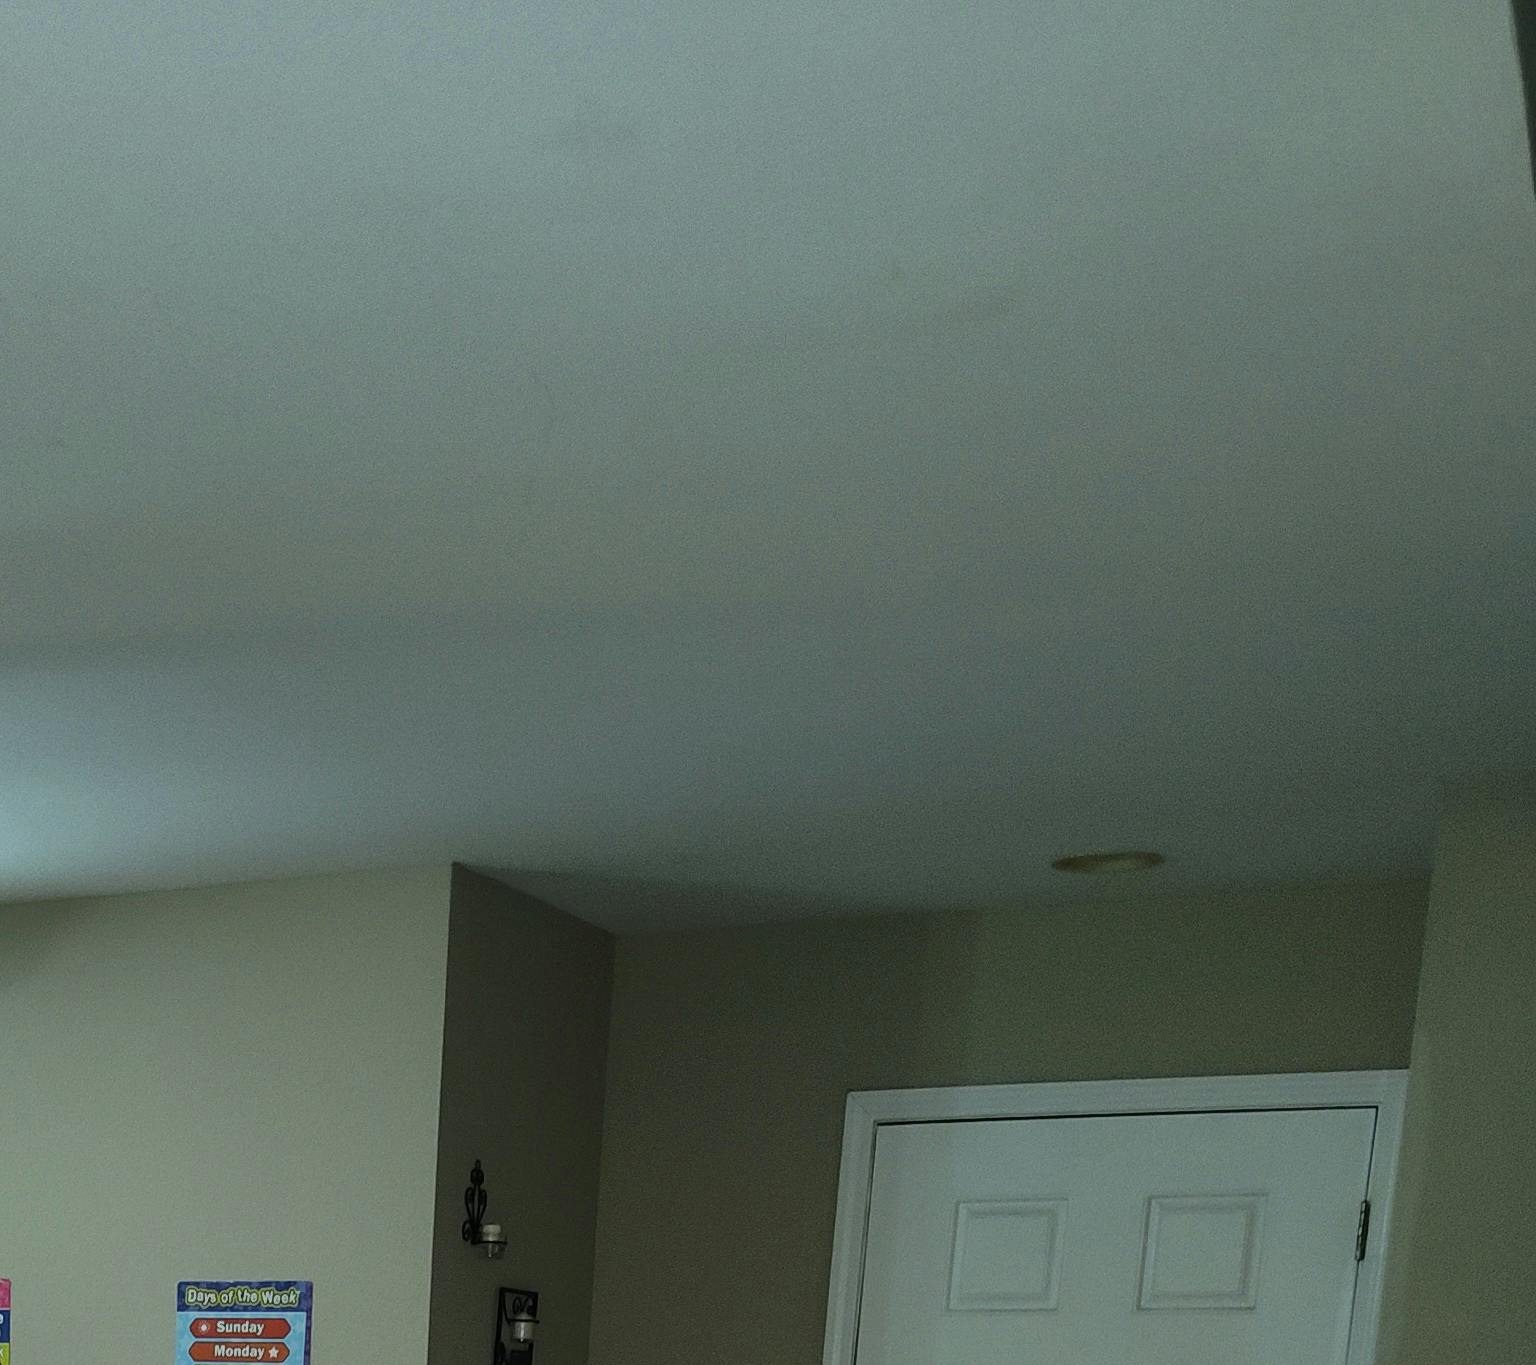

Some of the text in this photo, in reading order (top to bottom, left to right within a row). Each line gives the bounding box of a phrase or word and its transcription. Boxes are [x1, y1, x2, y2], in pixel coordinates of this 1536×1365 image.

[186, 1288, 299, 1306] Days of the Week
[216, 1321, 264, 1336] Sunday
[214, 1345, 265, 1360] Monday
